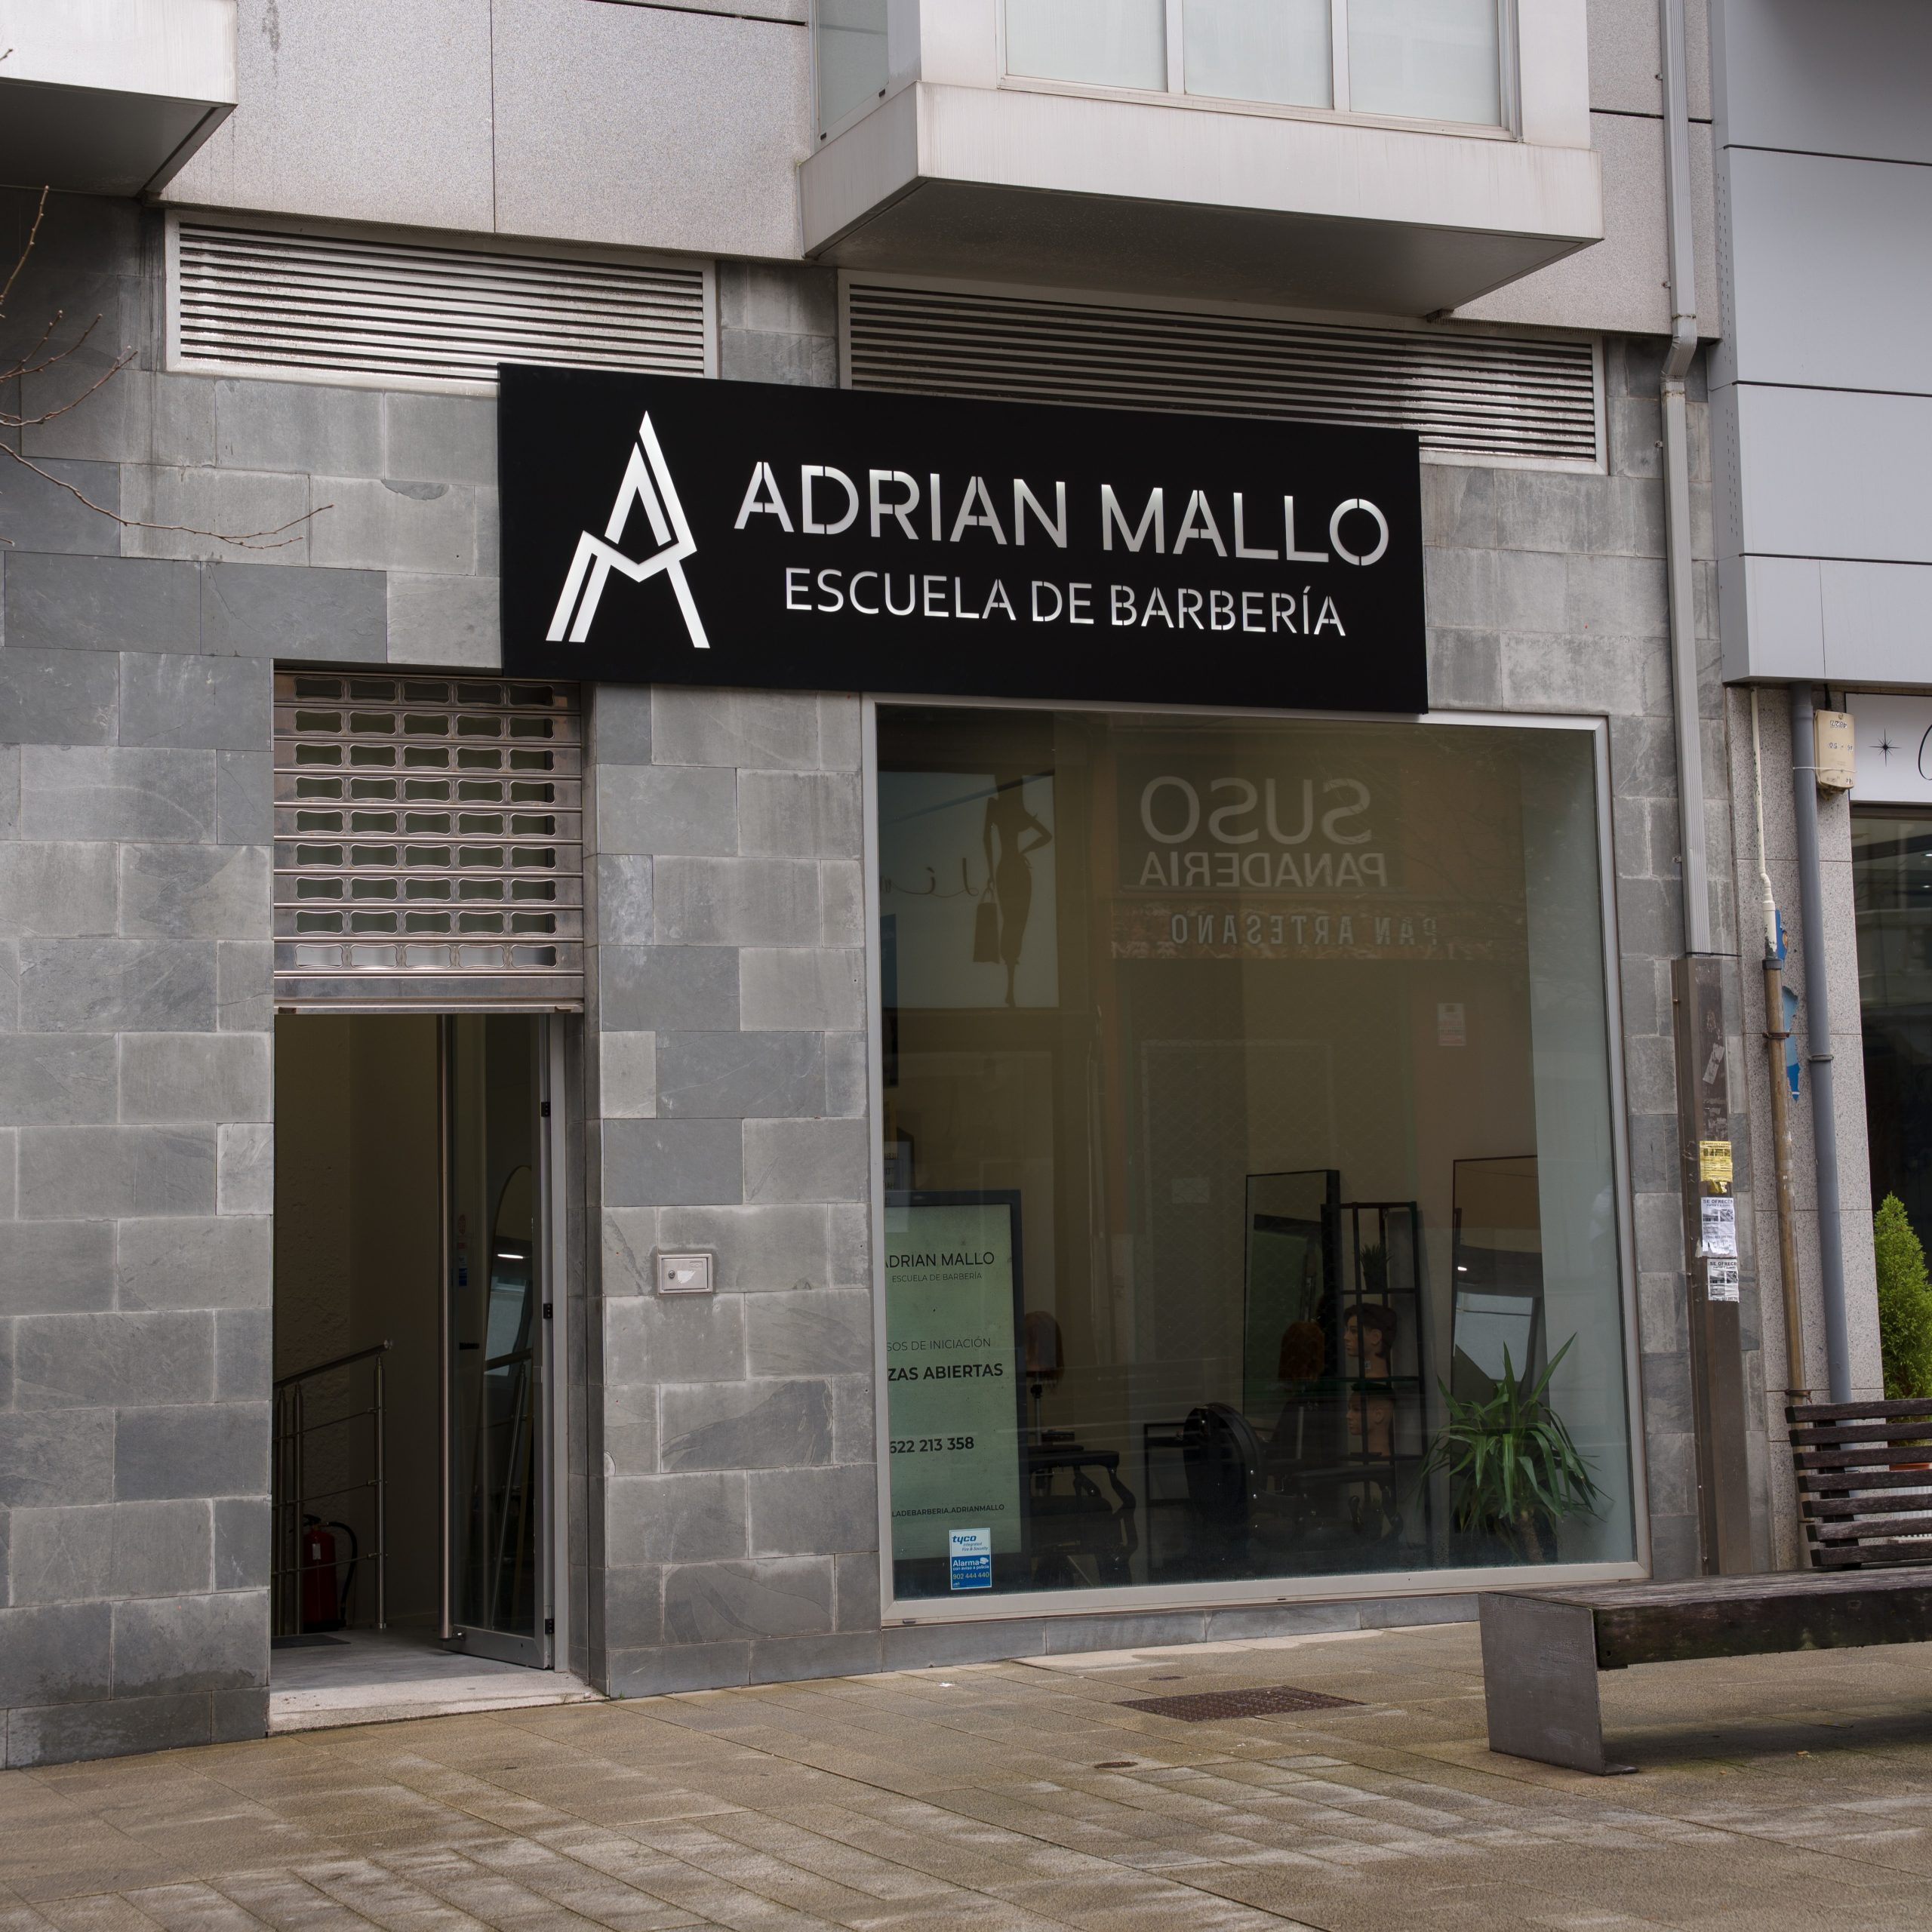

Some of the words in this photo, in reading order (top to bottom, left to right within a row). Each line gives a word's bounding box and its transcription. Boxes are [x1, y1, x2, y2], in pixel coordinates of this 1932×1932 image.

[734, 461, 1067, 549] ADRIAN
[1100, 484, 1389, 566] MALLO
[786, 567, 1017, 621] ESCUELA
[1031, 580, 1094, 625] DE
[1110, 584, 1346, 637] BARBERÍA
[941, 1251, 995, 1266] MALLO
[892, 1274, 928, 1283] ESCUELA
[930, 1273, 940, 1281] DE
[943, 1271, 983, 1281] BARBERÍA
[911, 1340, 926, 1351] DE
[930, 1336, 991, 1349] INICIACIÓN
[888, 1367, 918, 1381] ZAS
[923, 1363, 1004, 1380] ABIERTAS
[919, 1438, 943, 1452] 213
[947, 1436, 974, 1451] 358
[952, 1535, 977, 1545] tyco
